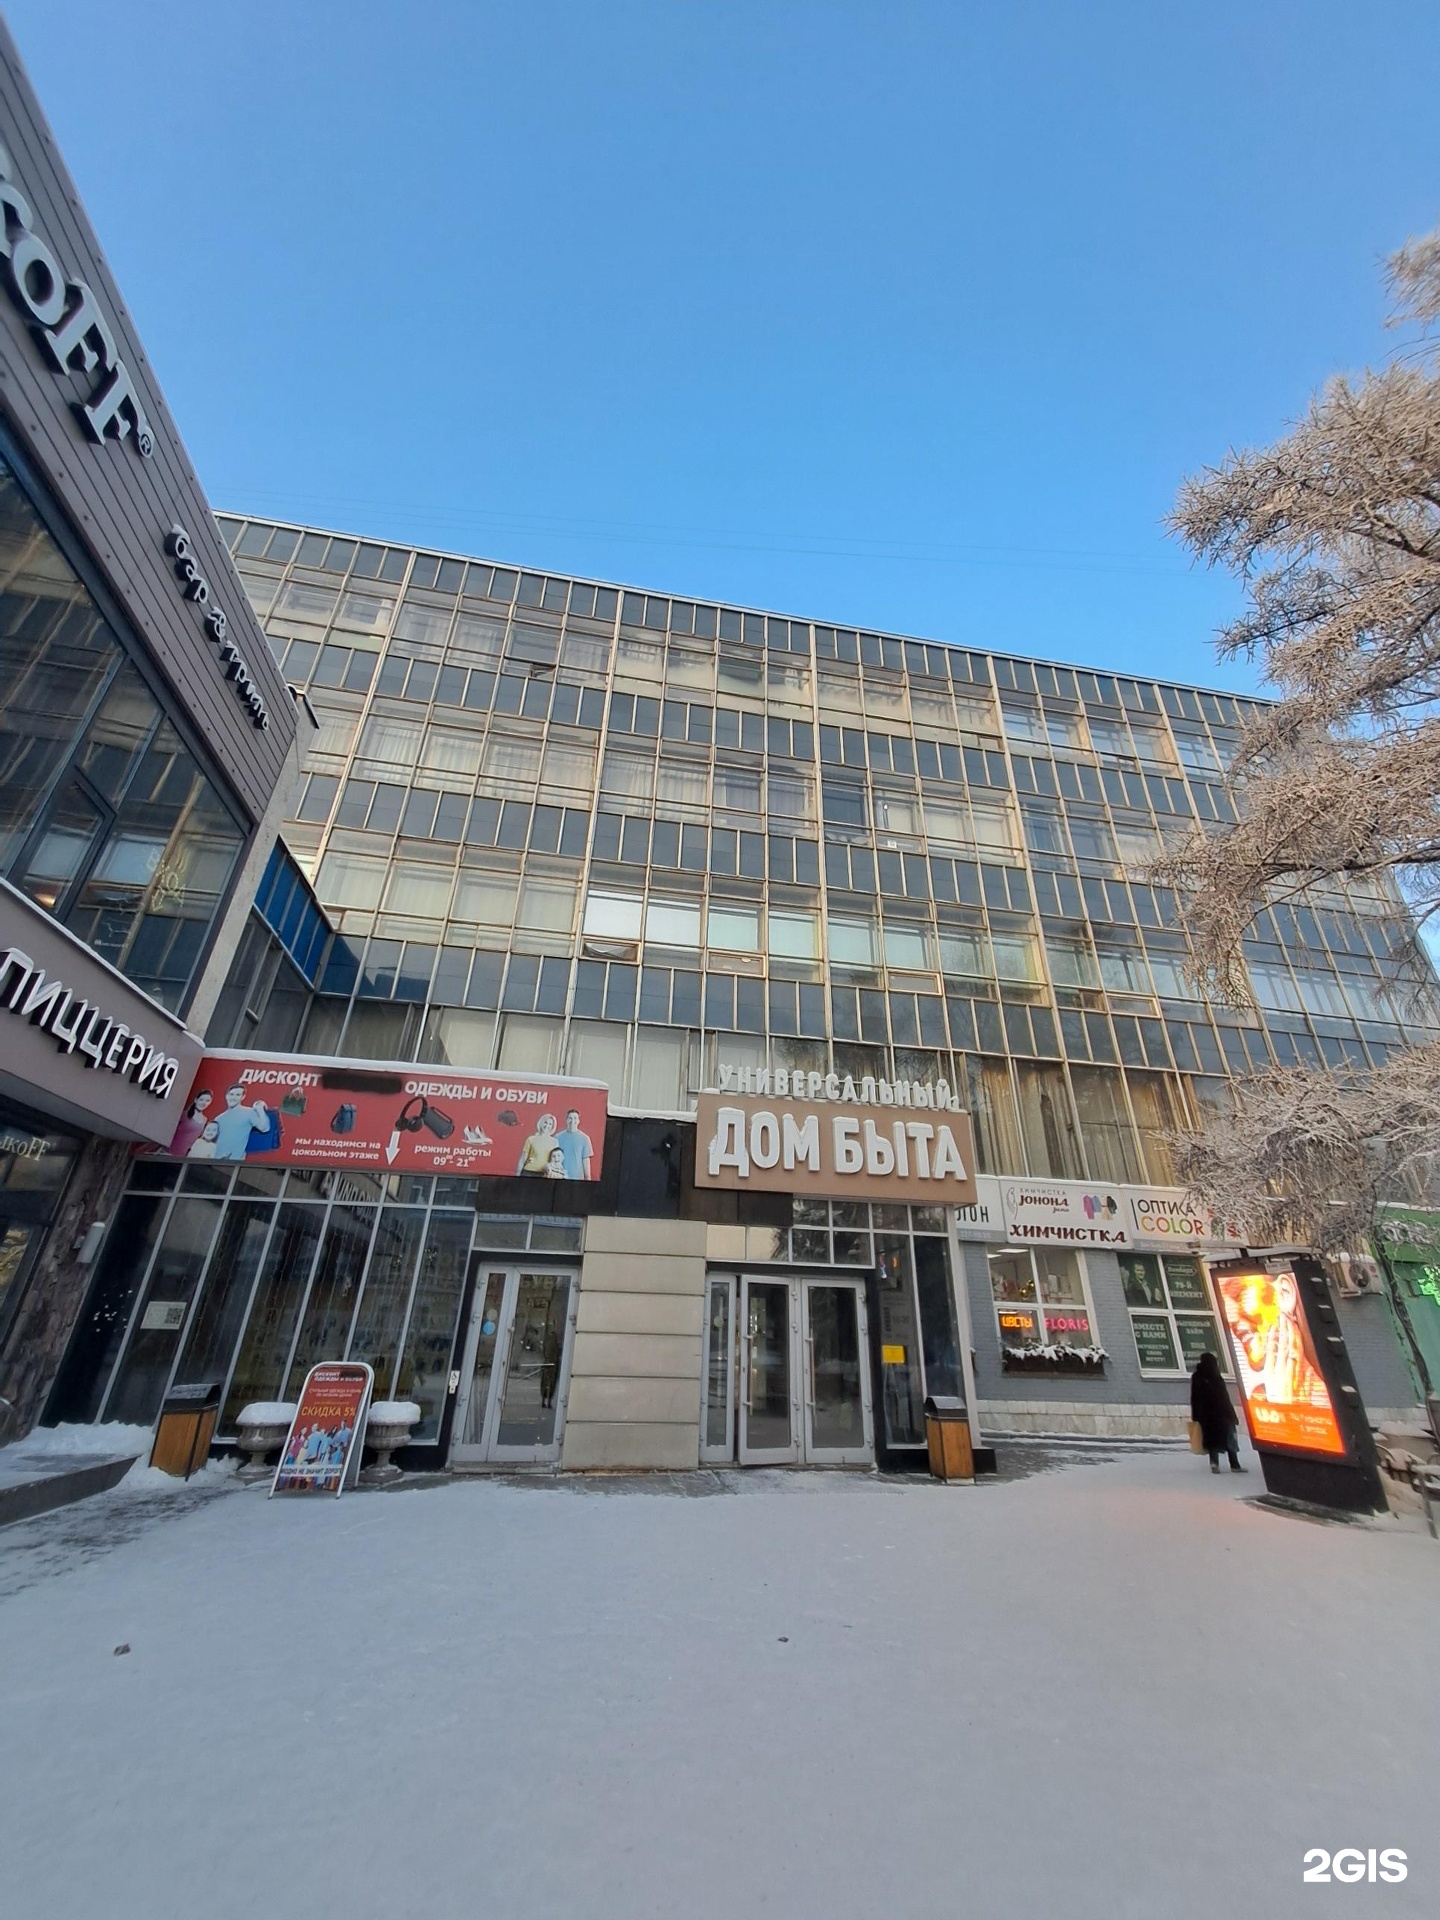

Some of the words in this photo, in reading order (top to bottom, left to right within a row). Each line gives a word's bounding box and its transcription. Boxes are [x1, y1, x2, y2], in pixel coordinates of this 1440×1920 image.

[0, 947, 179, 1099] ПИЦЦЕРИЯ
[239, 1068, 322, 1087] ДИСКОНТ
[405, 1080, 477, 1100] ОДЕЖДЫ
[480, 1088, 493, 1101] И
[495, 1089, 549, 1105] ОБУВИ
[719, 1064, 952, 1111] УНИВЕРСАЛЬНЫЙ
[294, 1136, 312, 1146] мы
[313, 1139, 367, 1150] находимся
[369, 1141, 381, 1150] на
[414, 1144, 451, 1155] режим
[453, 1147, 492, 1158] работы
[708, 1106, 820, 1178] ДОМ
[832, 1116, 968, 1181] БЫТА
[291, 1149, 347, 1159] цокольном
[349, 1151, 379, 1161] этаже
[1019, 1187, 1067, 1197] ХИМЧИСТКА
[1137, 1198, 1197, 1218] ОПТИКА
[1009, 1224, 1128, 1244] ХИМЧИСТКА
[1140, 1214, 1205, 1236] COLOR
[1043, 1317, 1089, 1331] FLORIS
[301, 1406, 341, 1418] СКИДКА
[343, 1406, 356, 1417] 5%
